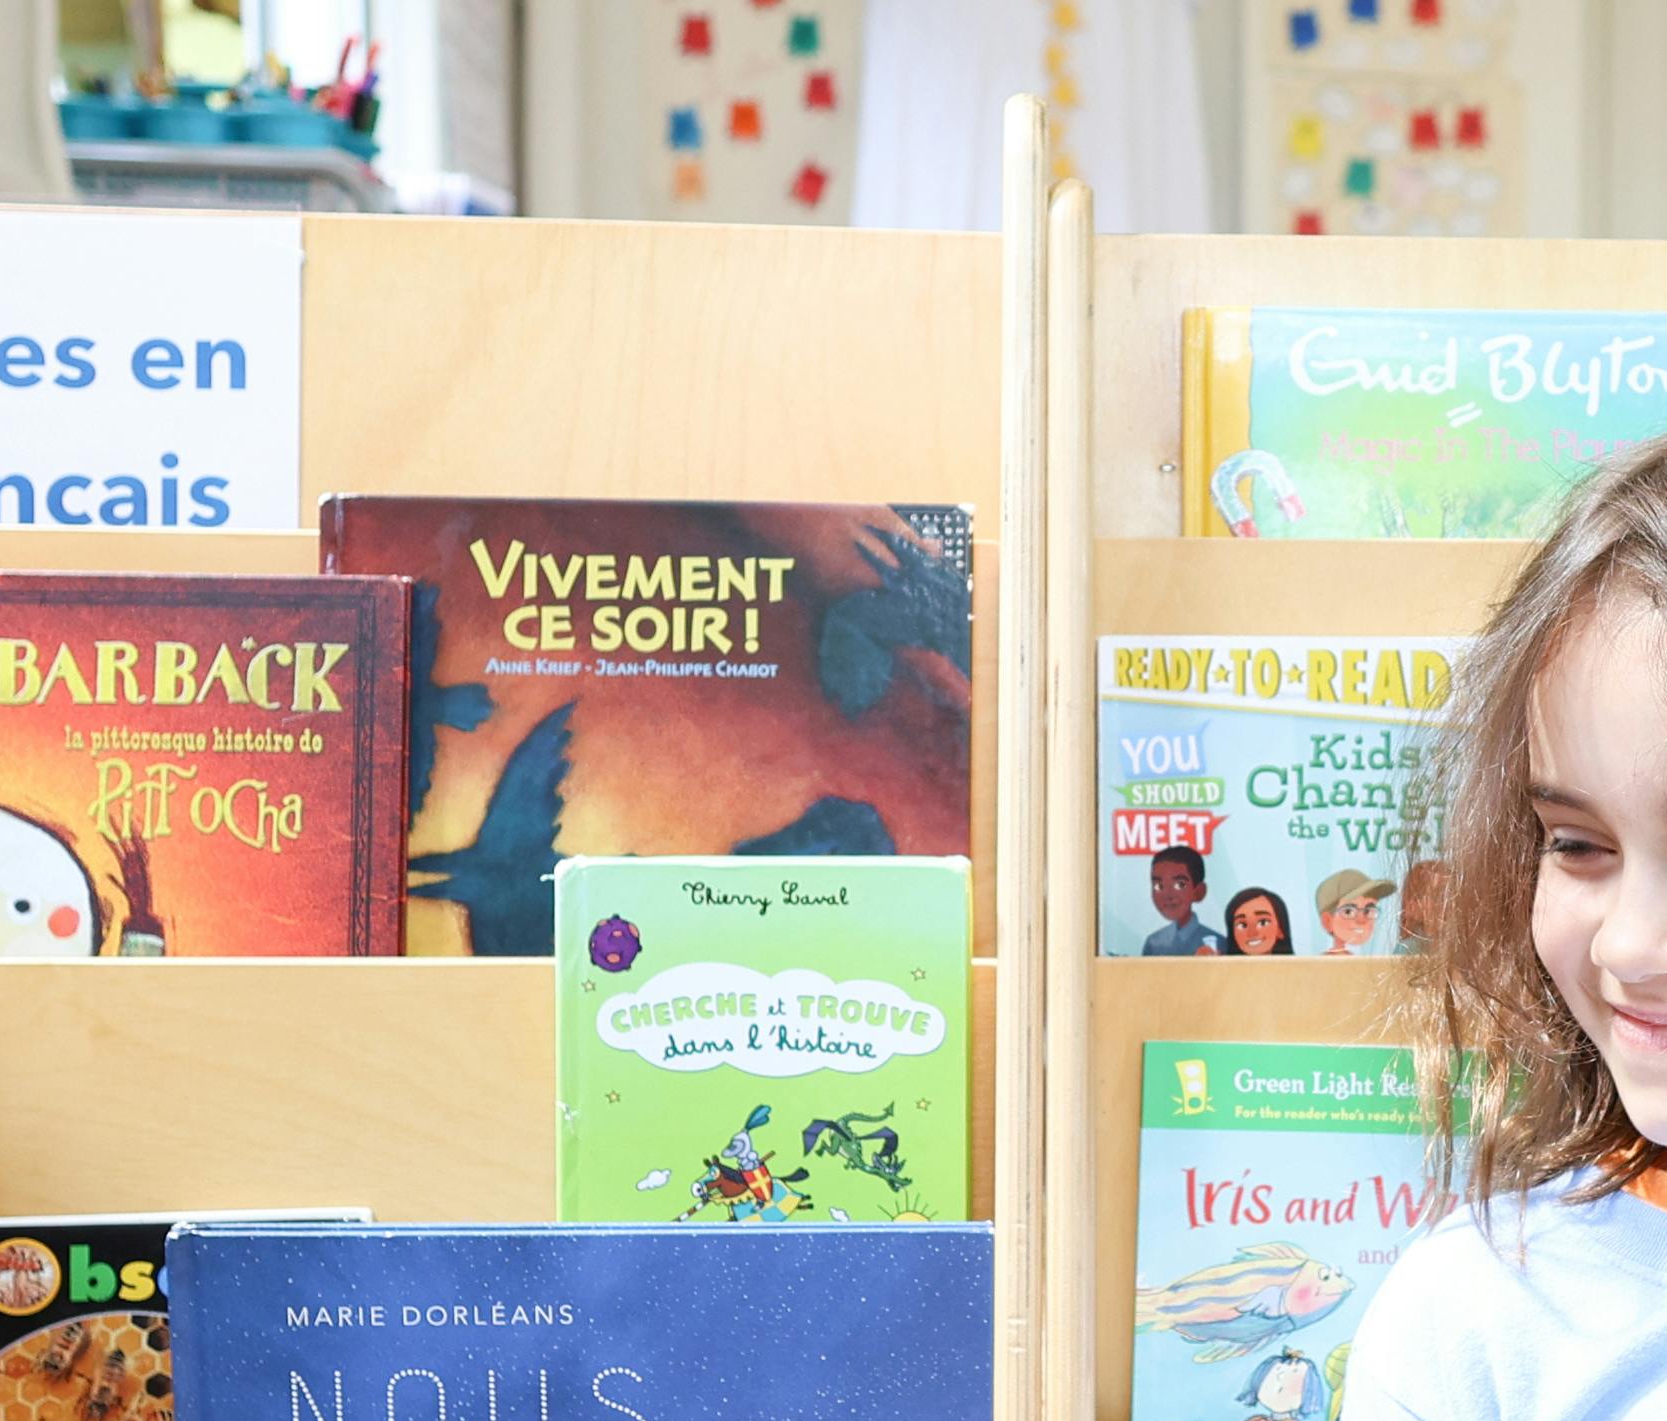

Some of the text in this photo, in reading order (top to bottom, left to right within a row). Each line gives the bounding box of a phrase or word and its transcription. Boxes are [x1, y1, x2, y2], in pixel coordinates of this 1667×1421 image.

[131, 338, 246, 390] en
[1289, 326, 1457, 397] Enid
[1319, 430, 1423, 476] Magic
[1479, 427, 1541, 463] The
[470, 538, 794, 603] VIVEMENT
[504, 606, 574, 652] CE
[485, 657, 532, 676] ANNE
[64, 725, 323, 758] la pittoresque histoire de
[1121, 734, 1200, 774] YOU
[1309, 730, 1422, 771] Kids
[1131, 781, 1221, 807] SHOULD
[1116, 813, 1211, 853] MEET
[1288, 815, 1330, 839] the
[1337, 812, 1445, 855] Worl
[683, 879, 850, 916] Thierry Laval
[610, 992, 932, 1036] CHERCHE et TROUVE
[663, 1033, 733, 1062] dans
[1234, 1069, 1306, 1094] Green
[1312, 1071, 1374, 1101] Light
[1234, 1105, 1257, 1118] For
[1259, 1106, 1281, 1119] the
[1284, 1107, 1327, 1120] reader
[1331, 1107, 1364, 1121] who's
[1368, 1109, 1405, 1124] ready
[1181, 1167, 1273, 1229] Iris
[1285, 1181, 1360, 1226] and
[1358, 1245, 1398, 1265] and
[286, 1300, 575, 1328] MARIE DORLÉANS
